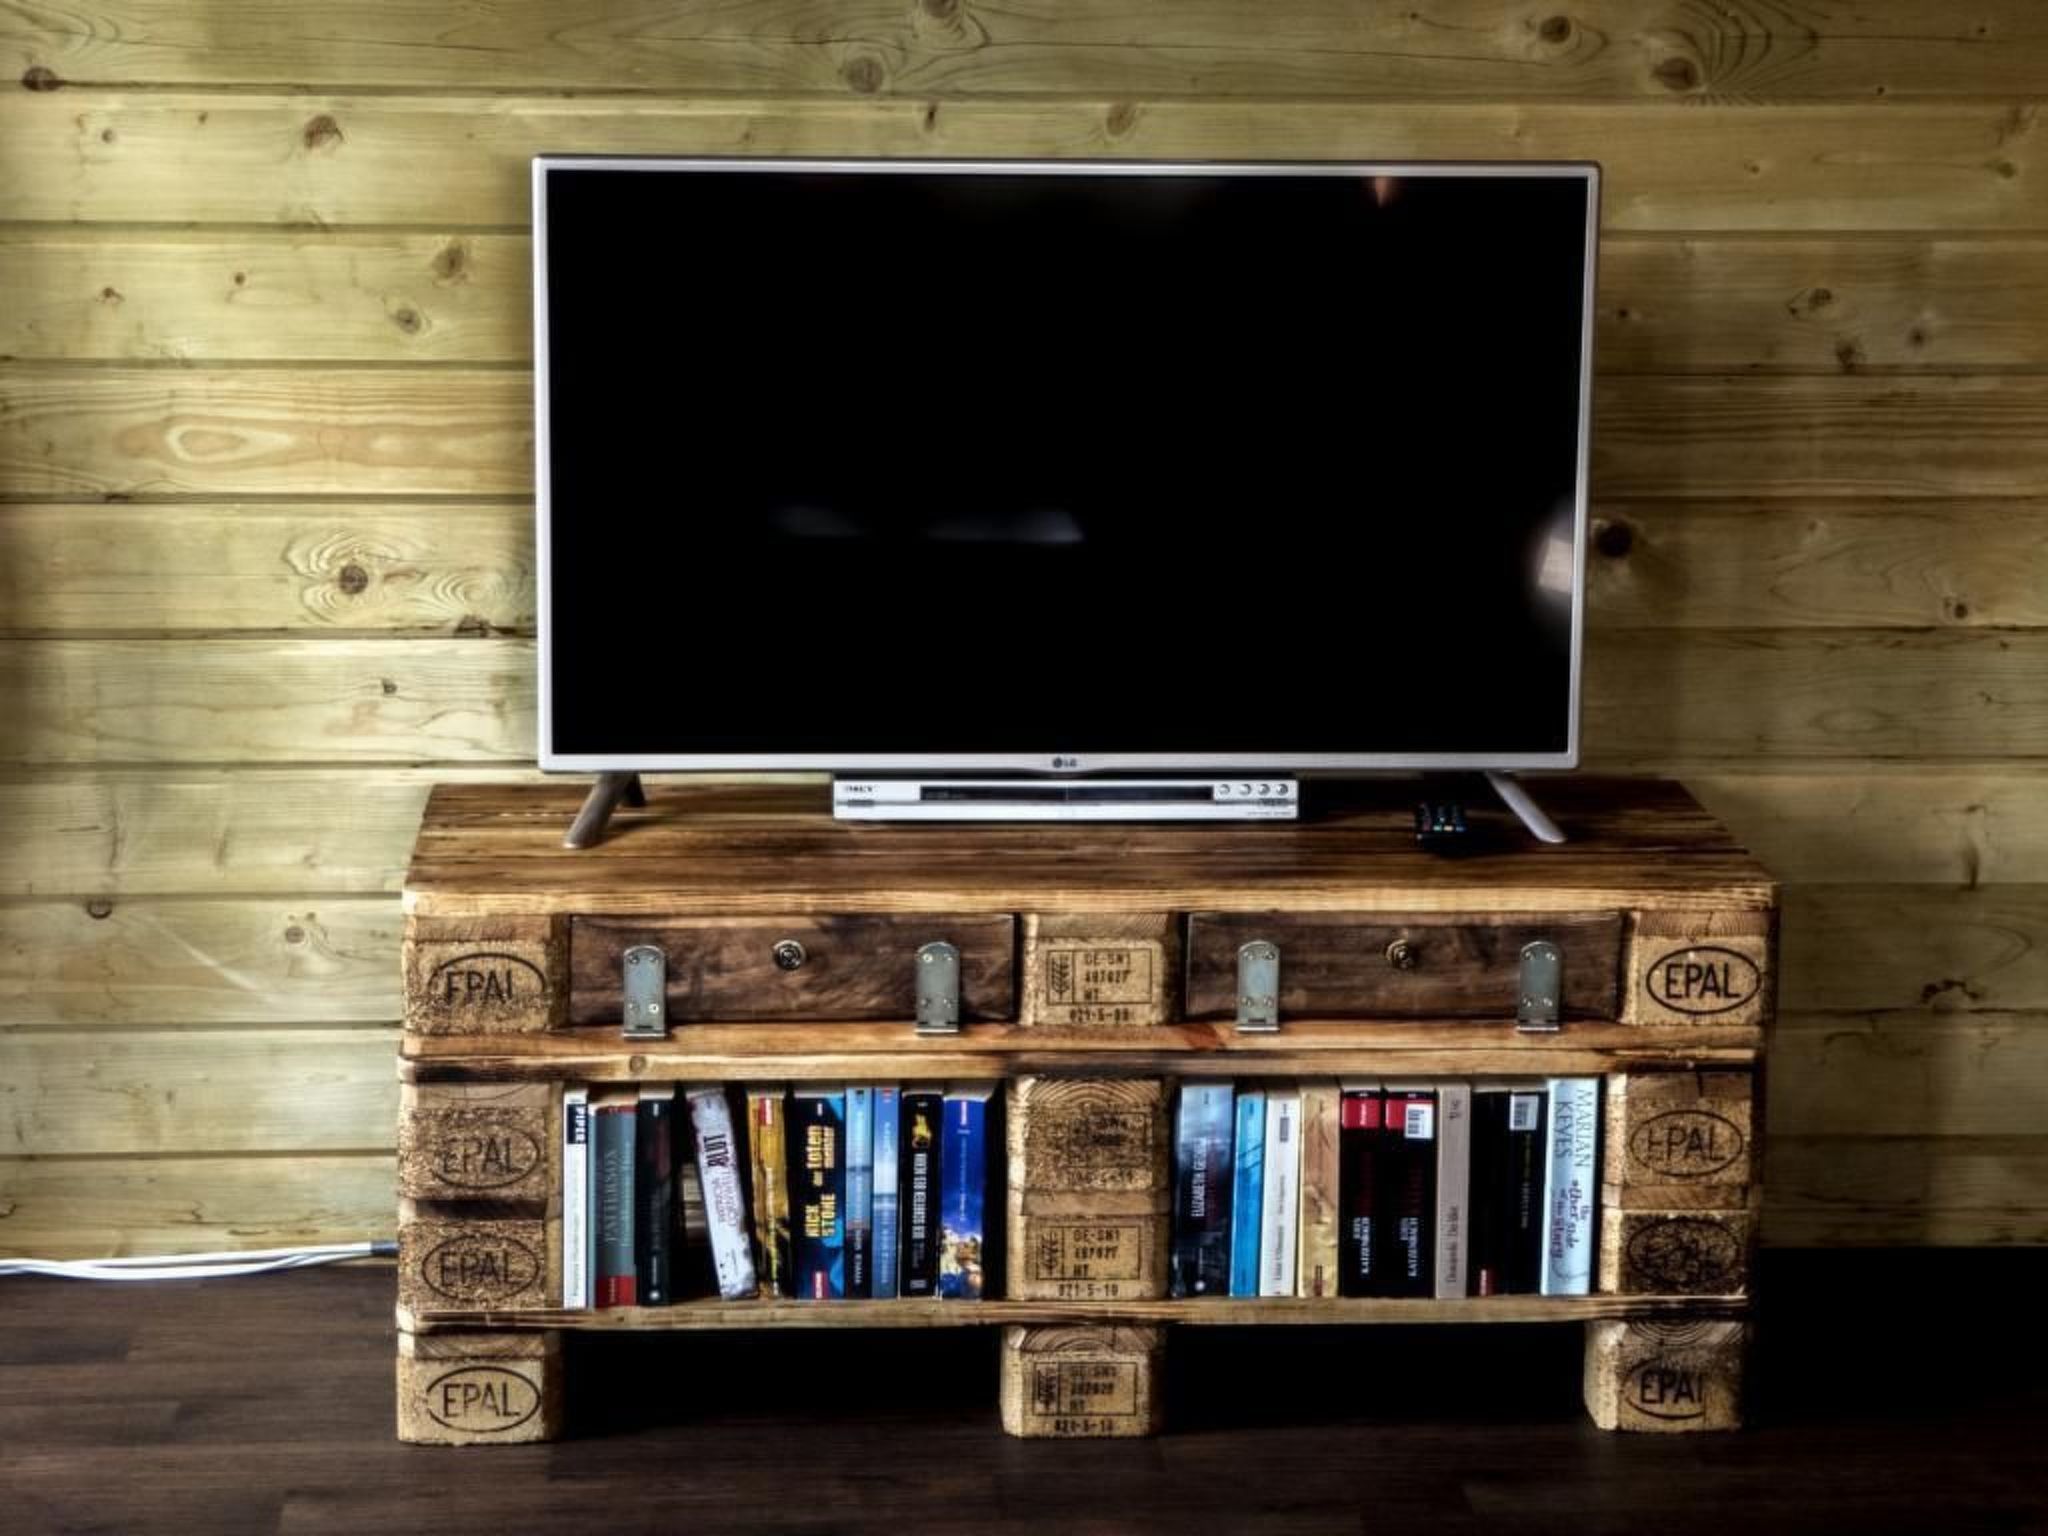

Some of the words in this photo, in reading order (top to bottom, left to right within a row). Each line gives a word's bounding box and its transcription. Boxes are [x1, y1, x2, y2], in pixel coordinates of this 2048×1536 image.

[1665, 961, 1740, 999] EPAL
[574, 1106, 585, 1142] PIPER
[1554, 1100, 1574, 1159] KEYES
[1574, 1089, 1593, 1168] MARIAN
[1646, 1124, 1726, 1162] EPAL
[441, 1136, 523, 1174] EPAL
[704, 1134, 730, 1169] BLUT
[603, 1150, 618, 1243] PATTERSON
[1190, 1172, 1204, 1218] ELIZABETH
[1568, 1180, 1582, 1221] other
[806, 1205, 820, 1237] NICK
[821, 1193, 836, 1237] STONE
[1361, 1216, 1370, 1275] KATZENBACH
[1408, 1216, 1418, 1278] KATZENBACH
[1550, 1216, 1565, 1260] story
[1566, 1222, 1579, 1249] side
[439, 1249, 522, 1287] EPAL
[442, 1381, 521, 1418] EPAL
